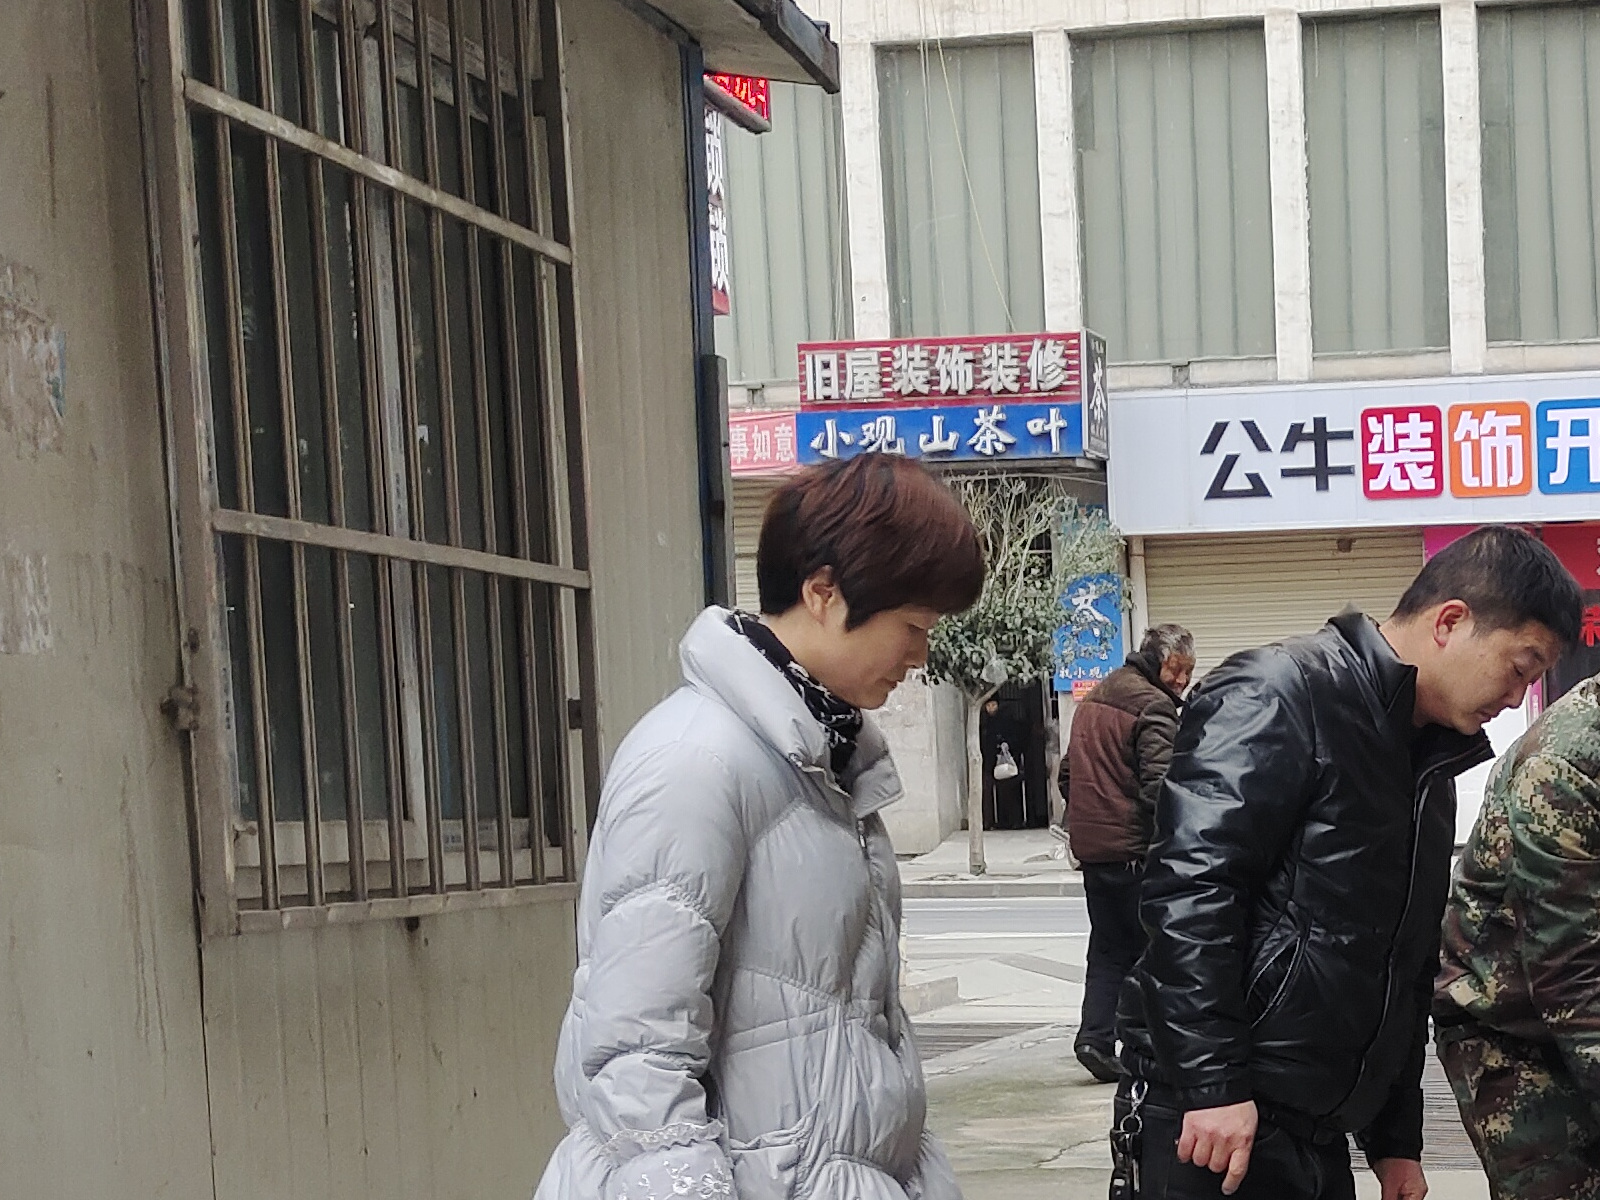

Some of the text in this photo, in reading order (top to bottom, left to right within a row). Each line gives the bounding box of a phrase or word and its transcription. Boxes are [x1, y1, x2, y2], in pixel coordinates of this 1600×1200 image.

[805, 338, 1069, 400] 旧屋装饰装修
[810, 404, 1068, 458] 小观山茶叶
